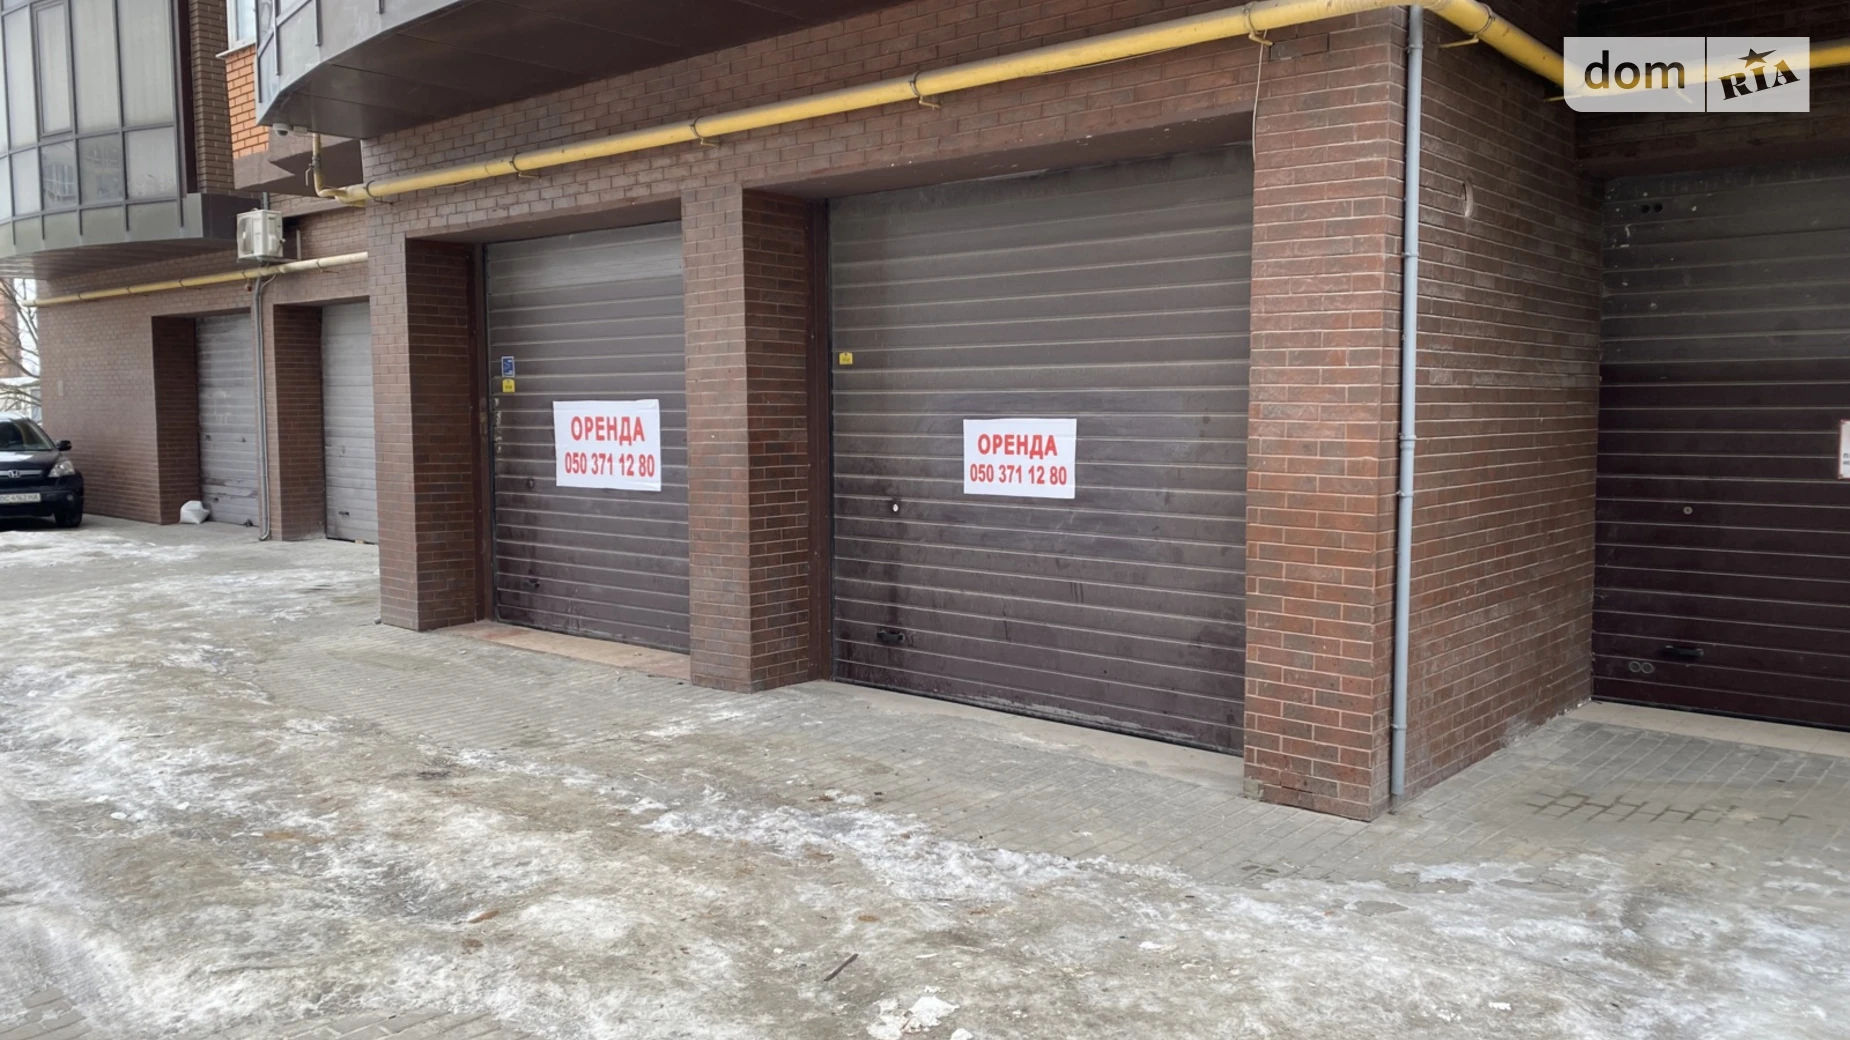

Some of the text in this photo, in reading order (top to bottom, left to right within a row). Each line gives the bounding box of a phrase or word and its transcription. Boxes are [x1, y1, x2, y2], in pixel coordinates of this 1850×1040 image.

[570, 416, 645, 446] ОРЕНДА
[977, 433, 1058, 460] ОРЕНДА
[565, 452, 655, 477] 050 371 12 80
[970, 464, 1067, 485] 050 371 12 80
